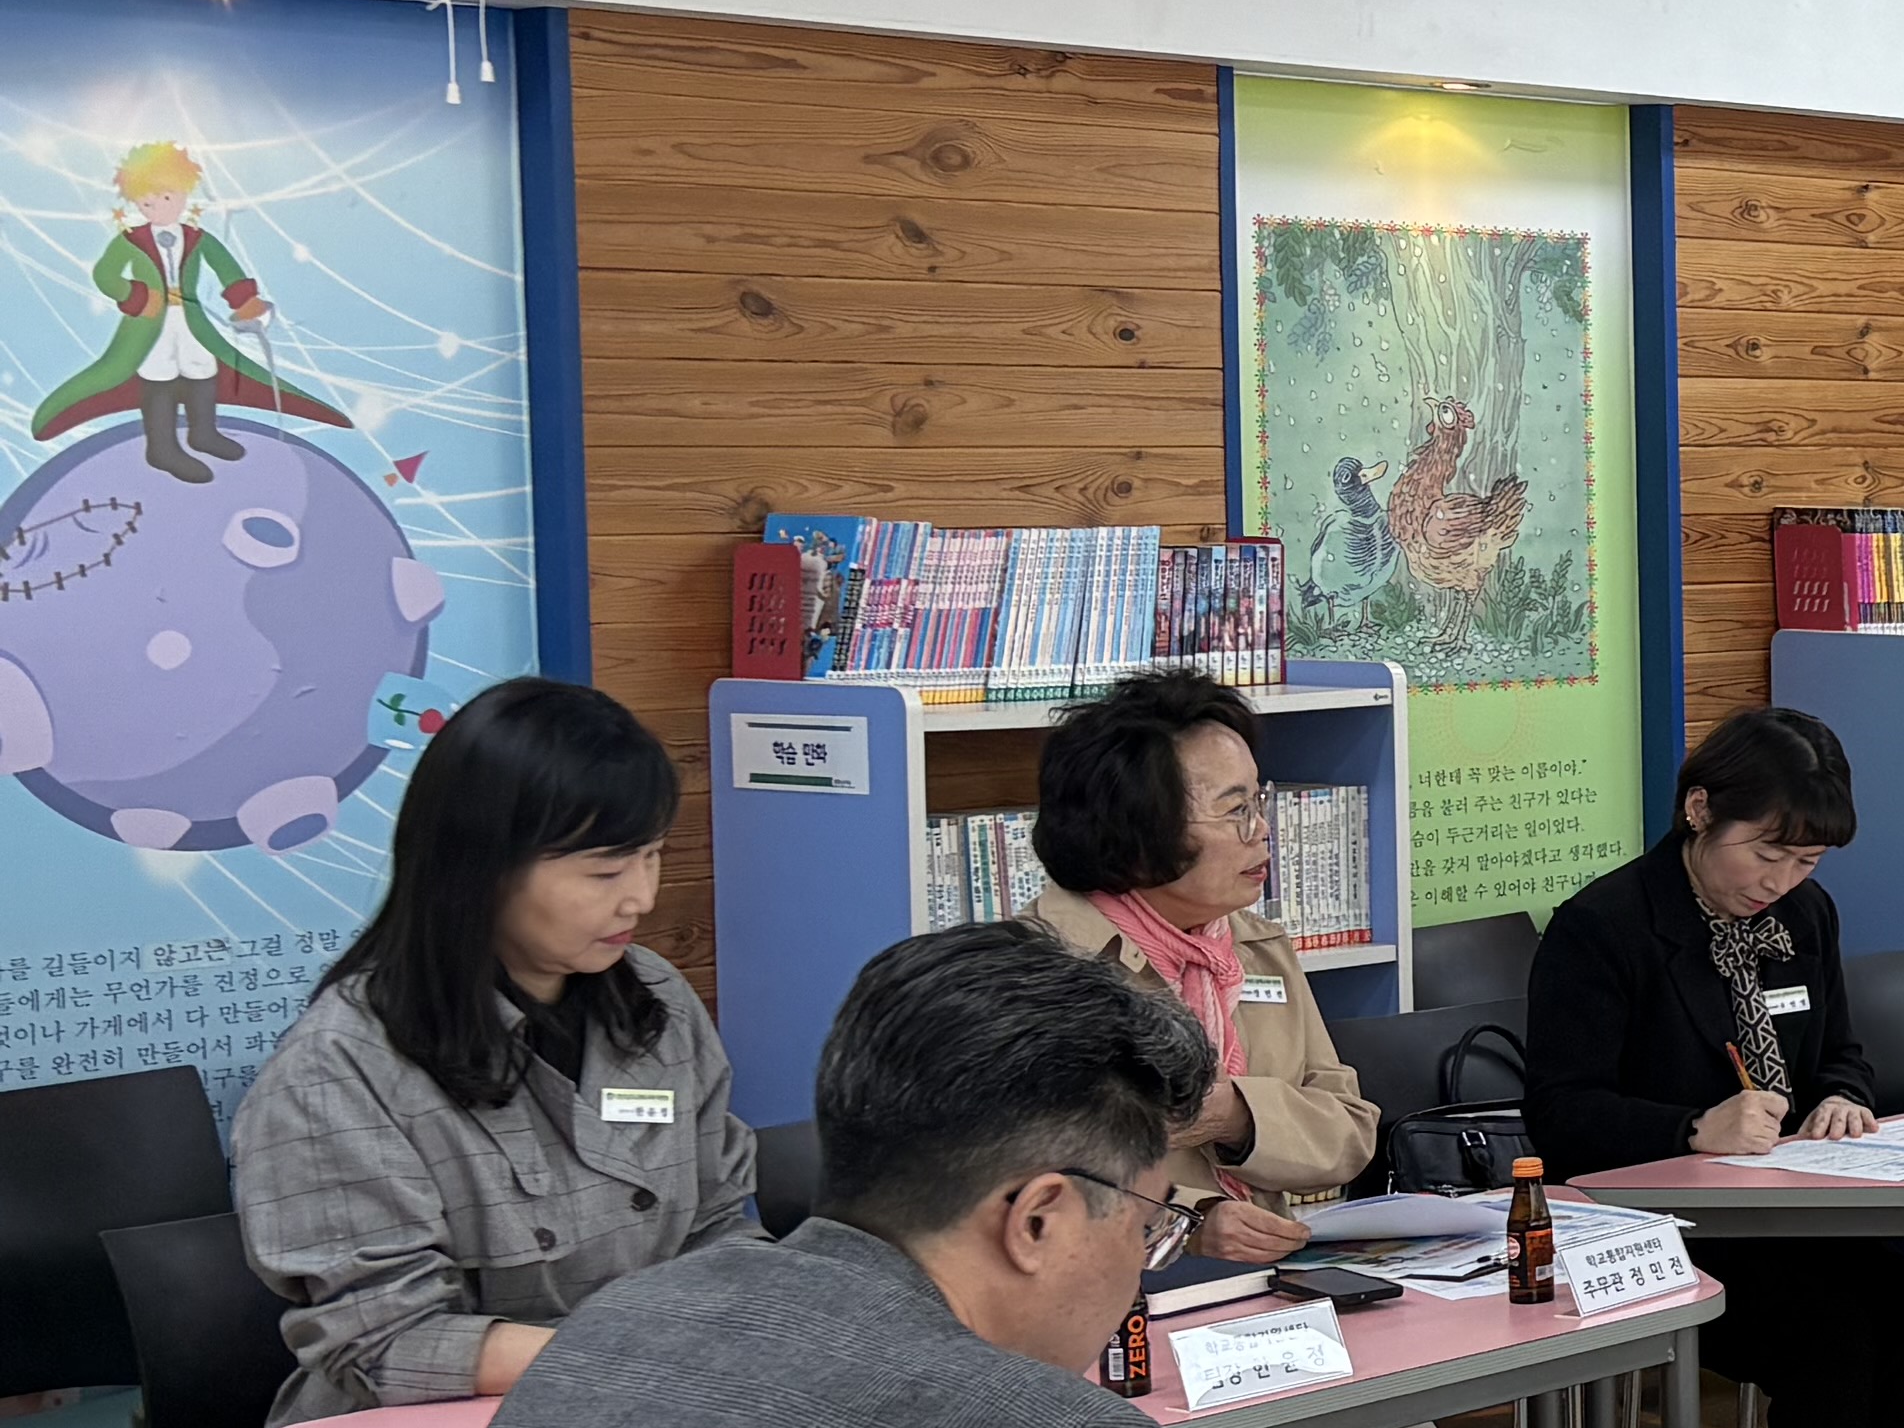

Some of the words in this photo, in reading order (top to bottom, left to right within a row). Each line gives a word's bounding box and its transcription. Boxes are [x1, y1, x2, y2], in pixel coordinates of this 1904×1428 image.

[772, 741, 798, 765] 학습
[802, 743, 828, 766] 만화
[1467, 768, 1482, 784] 꼭
[1488, 765, 1516, 783] 맞는
[1474, 795, 1504, 812] 주는
[1509, 789, 1551, 810] 친구가
[1556, 787, 1598, 805] 있다는
[1446, 823, 1519, 845] 두근거리는
[1474, 883, 1489, 900] 수
[1494, 877, 1537, 898] 있어야
[42, 946, 141, 978] 길들이지
[235, 934, 285, 958] 그걸
[295, 929, 341, 954] 정말
[103, 974, 203, 1004] 무언가를
[214, 966, 310, 993] 진정으로
[75, 1008, 173, 1040] 가게에서
[185, 1005, 210, 1028] 다
[52, 1046, 123, 1076] 완전히
[137, 1035, 232, 1067] 만들어서
[1583, 1272, 1625, 1299] 주무관
[1127, 1315, 1146, 1379] ZERO
